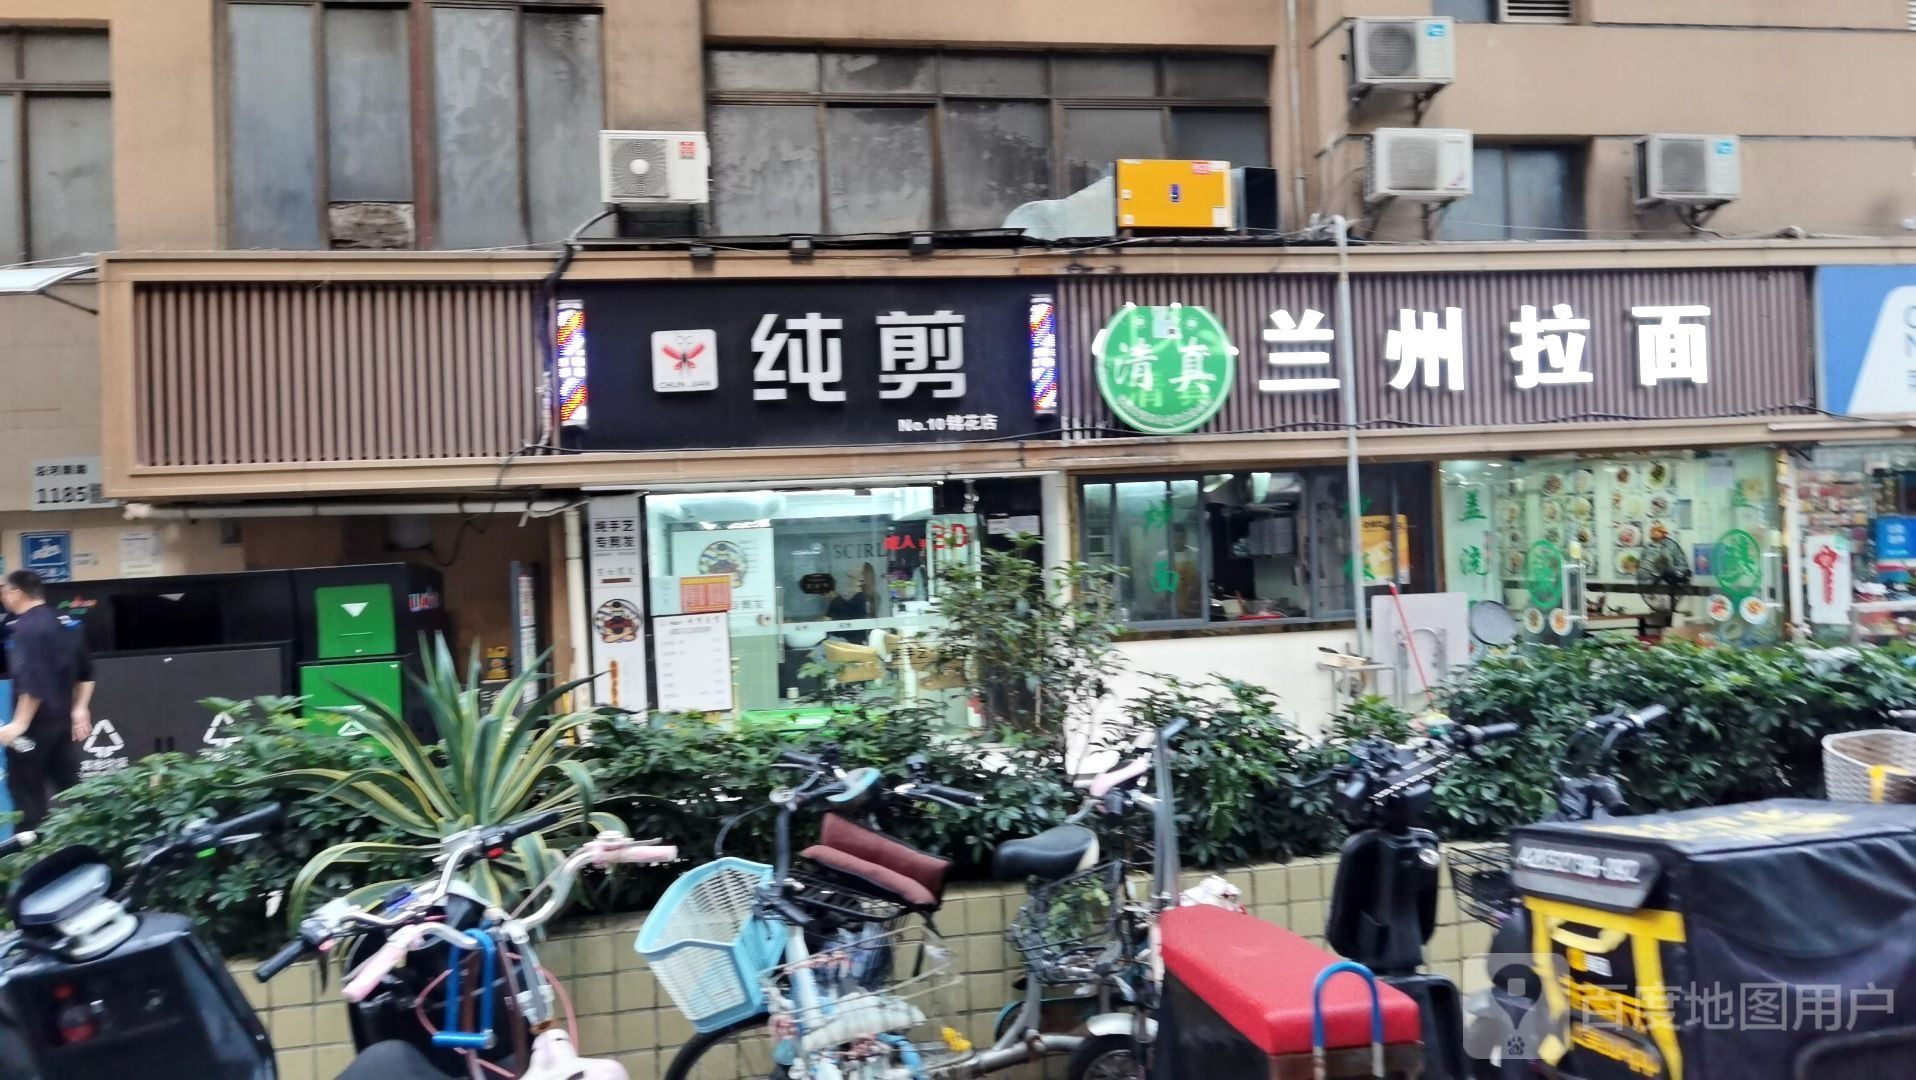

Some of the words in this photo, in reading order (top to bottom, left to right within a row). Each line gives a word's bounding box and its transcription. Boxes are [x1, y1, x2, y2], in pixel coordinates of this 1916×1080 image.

[750, 309, 968, 402] 纯剪
[1113, 336, 1218, 392] 清真
[1258, 303, 1713, 393] 兰州拉面
